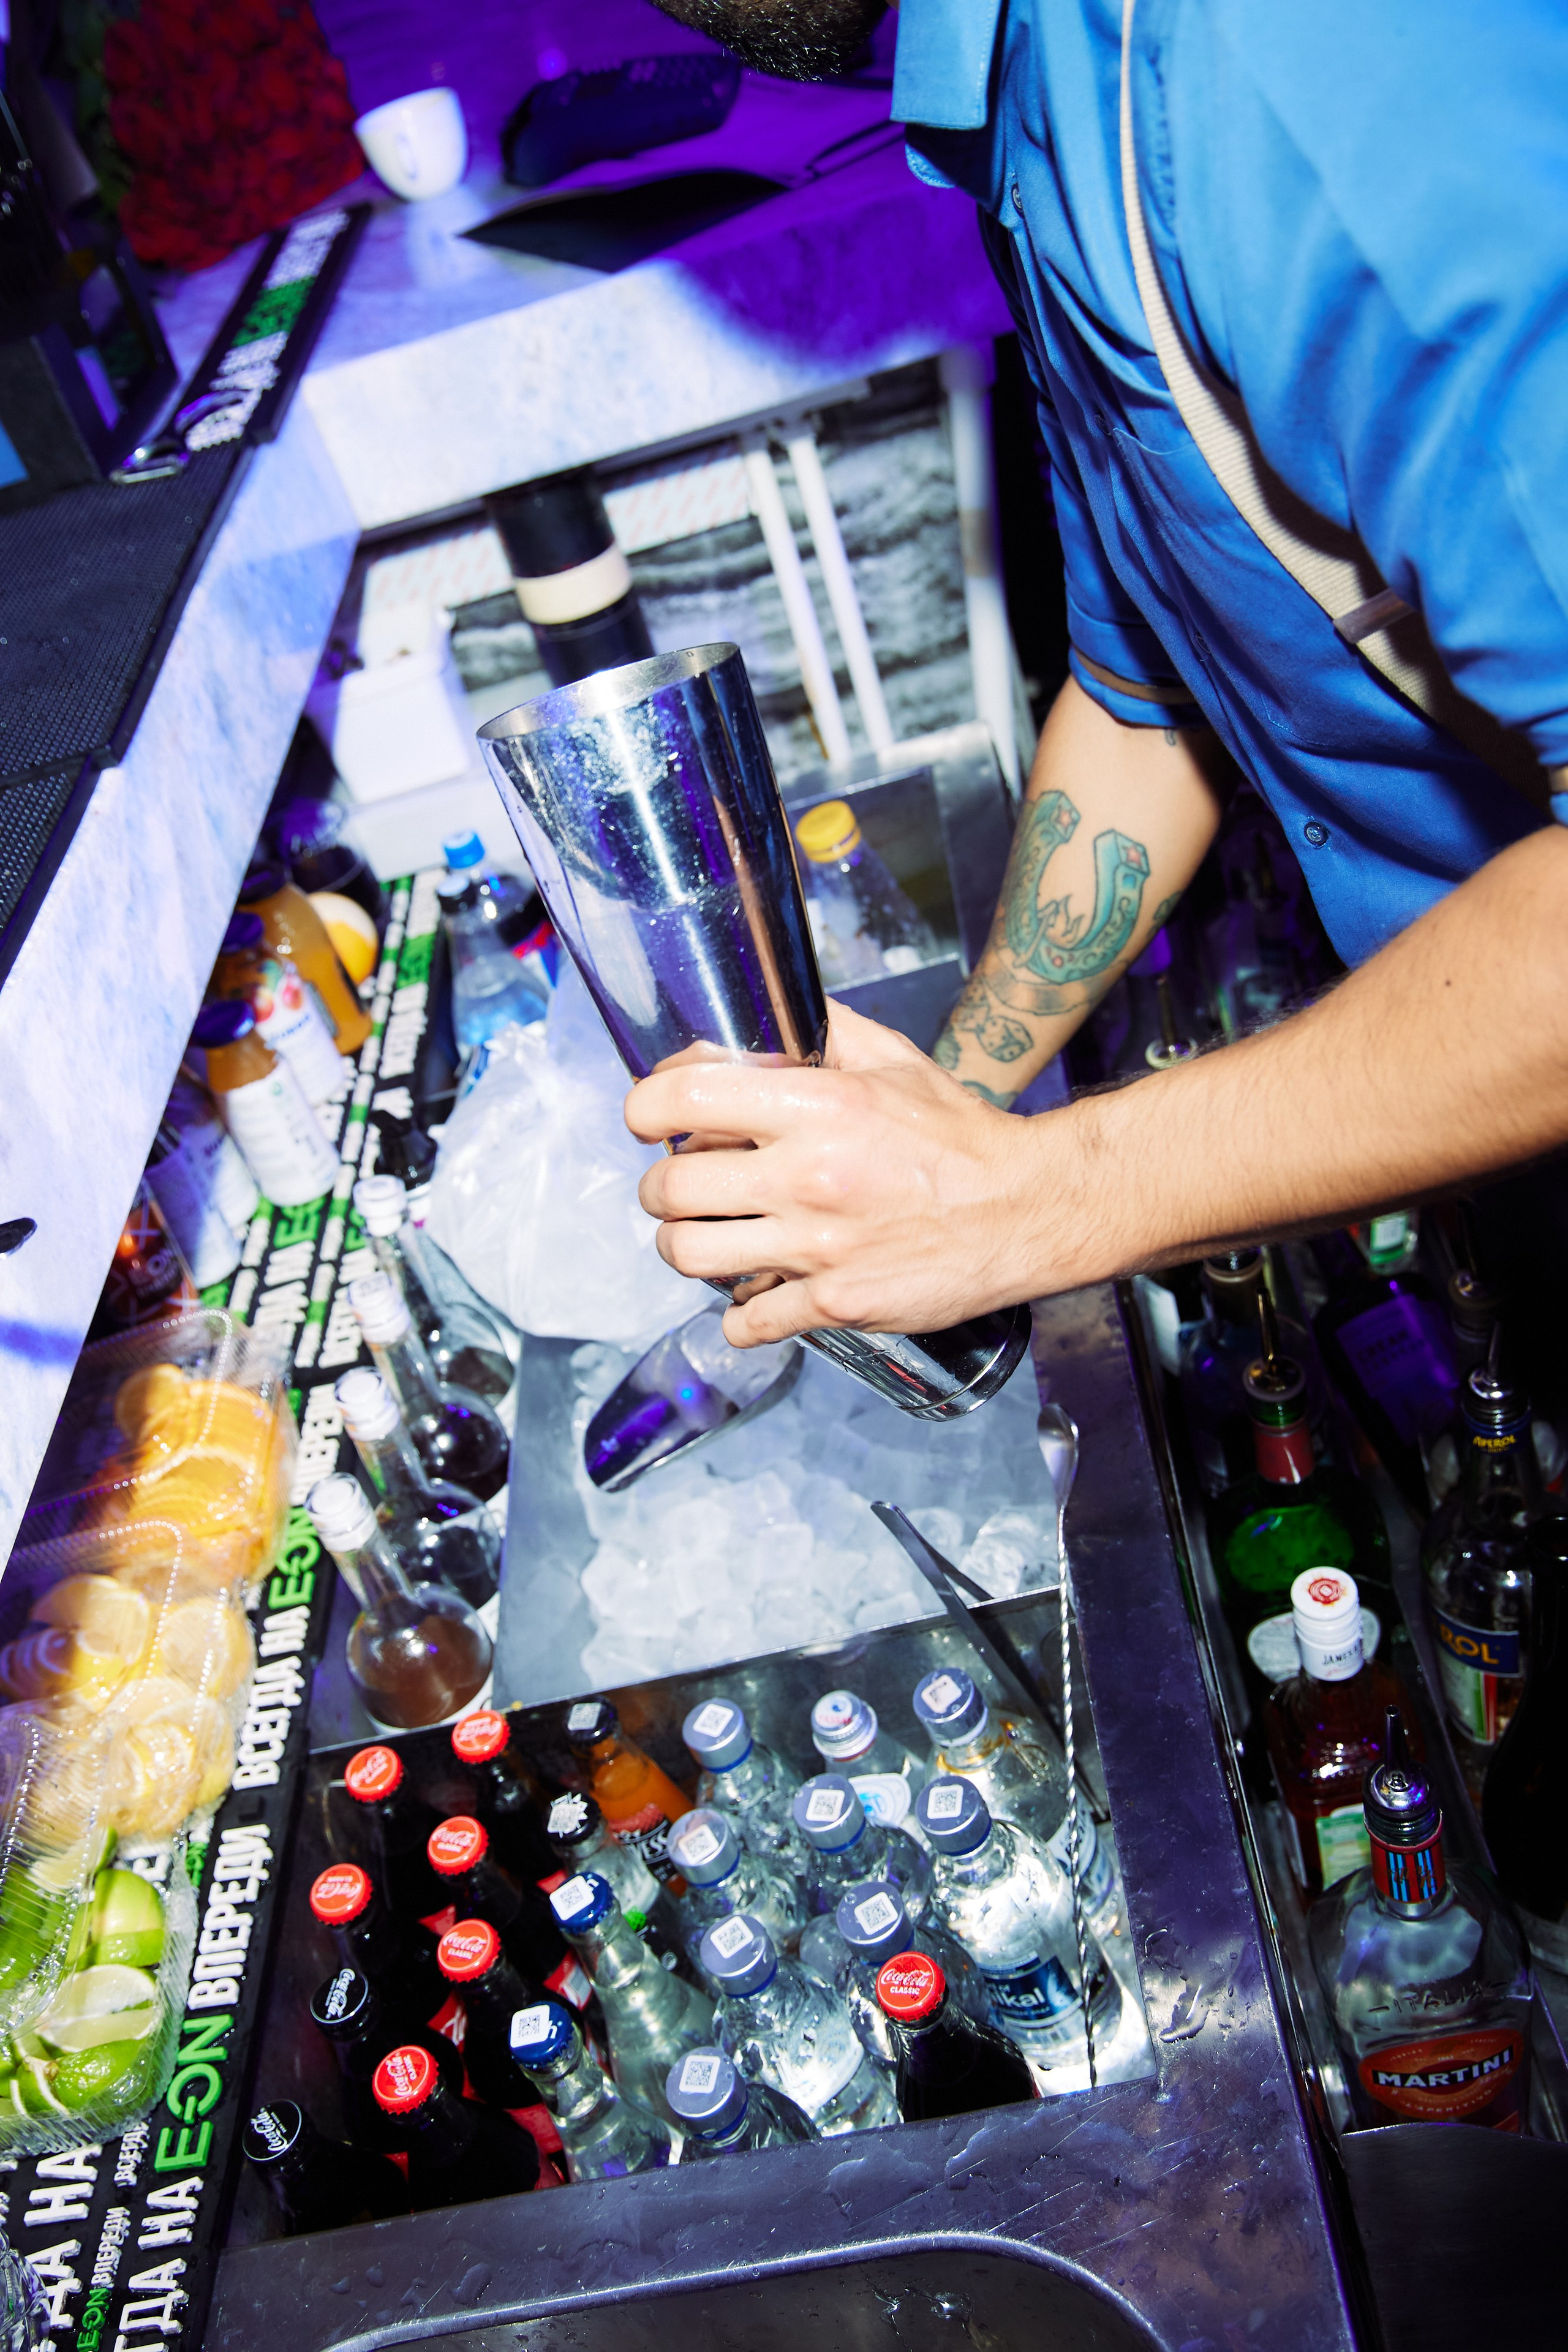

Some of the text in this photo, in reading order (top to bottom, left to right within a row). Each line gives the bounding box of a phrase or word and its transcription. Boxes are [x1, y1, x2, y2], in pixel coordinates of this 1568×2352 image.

[259, 1605, 311, 1657] НА
[1439, 1623, 1500, 1665] ROL
[232, 1656, 306, 1791] ВСЕГДА
[187, 1823, 274, 2010] ВПЕРЕДИ
[890, 1986, 920, 1995] CLASSIC
[990, 1986, 1046, 2008] ikal
[1378, 2048, 1510, 2088] MARTINI
[24, 2143, 104, 2227] НА
[137, 2176, 205, 2250] НА
[91, 2206, 132, 2290] ВПЕРЕДИ
[114, 2258, 189, 2352] ГДА
